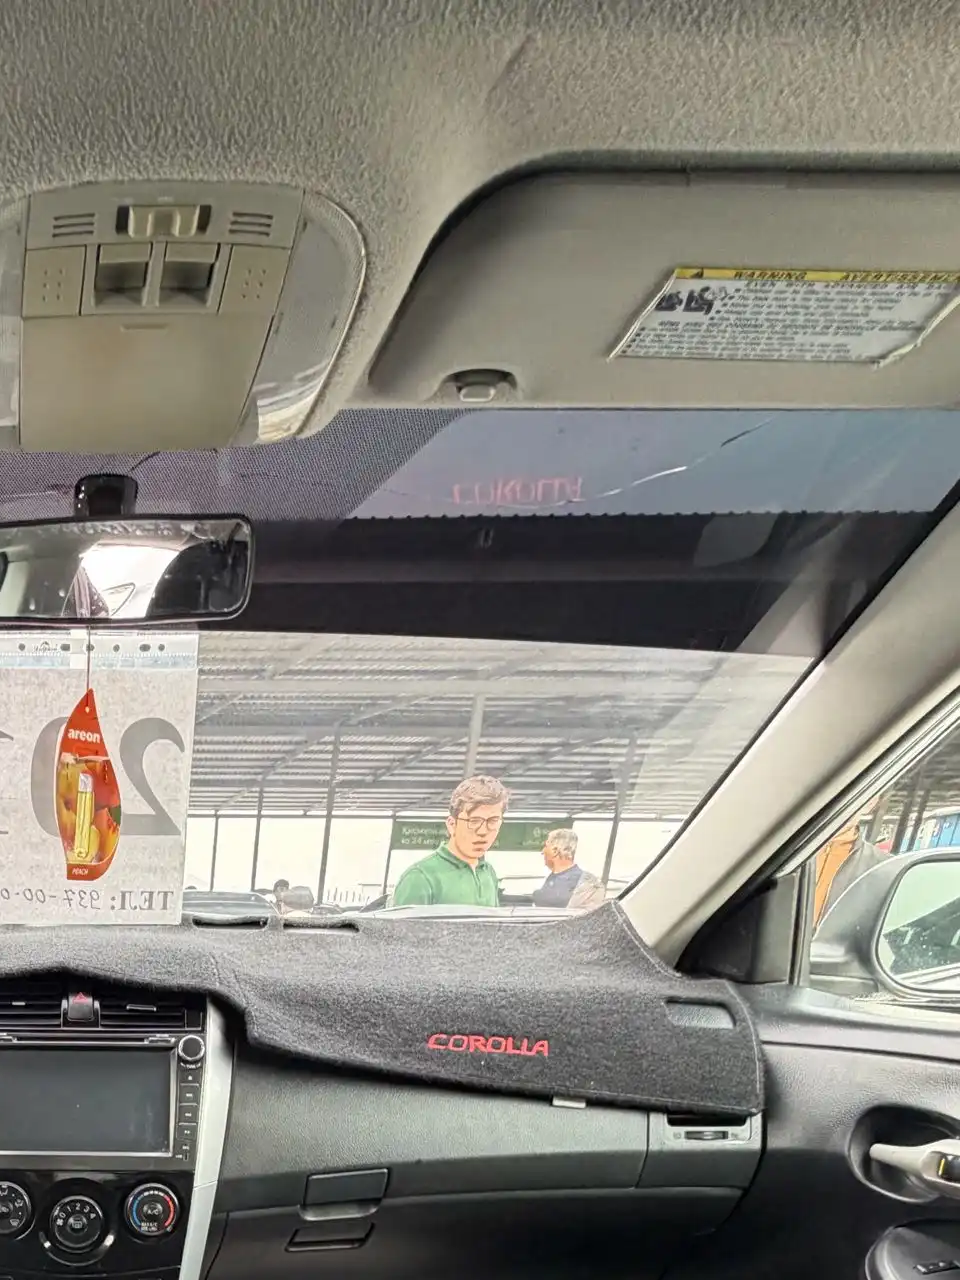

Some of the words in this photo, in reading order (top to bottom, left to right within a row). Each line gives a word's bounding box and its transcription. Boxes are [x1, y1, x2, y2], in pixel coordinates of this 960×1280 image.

[68, 728, 101, 744] areon
[427, 1033, 549, 1056] COROLLA
[75, 1202, 80, 1210] 2
[83, 1205, 90, 1213] 3
[147, 1208, 159, 1216] A/C
